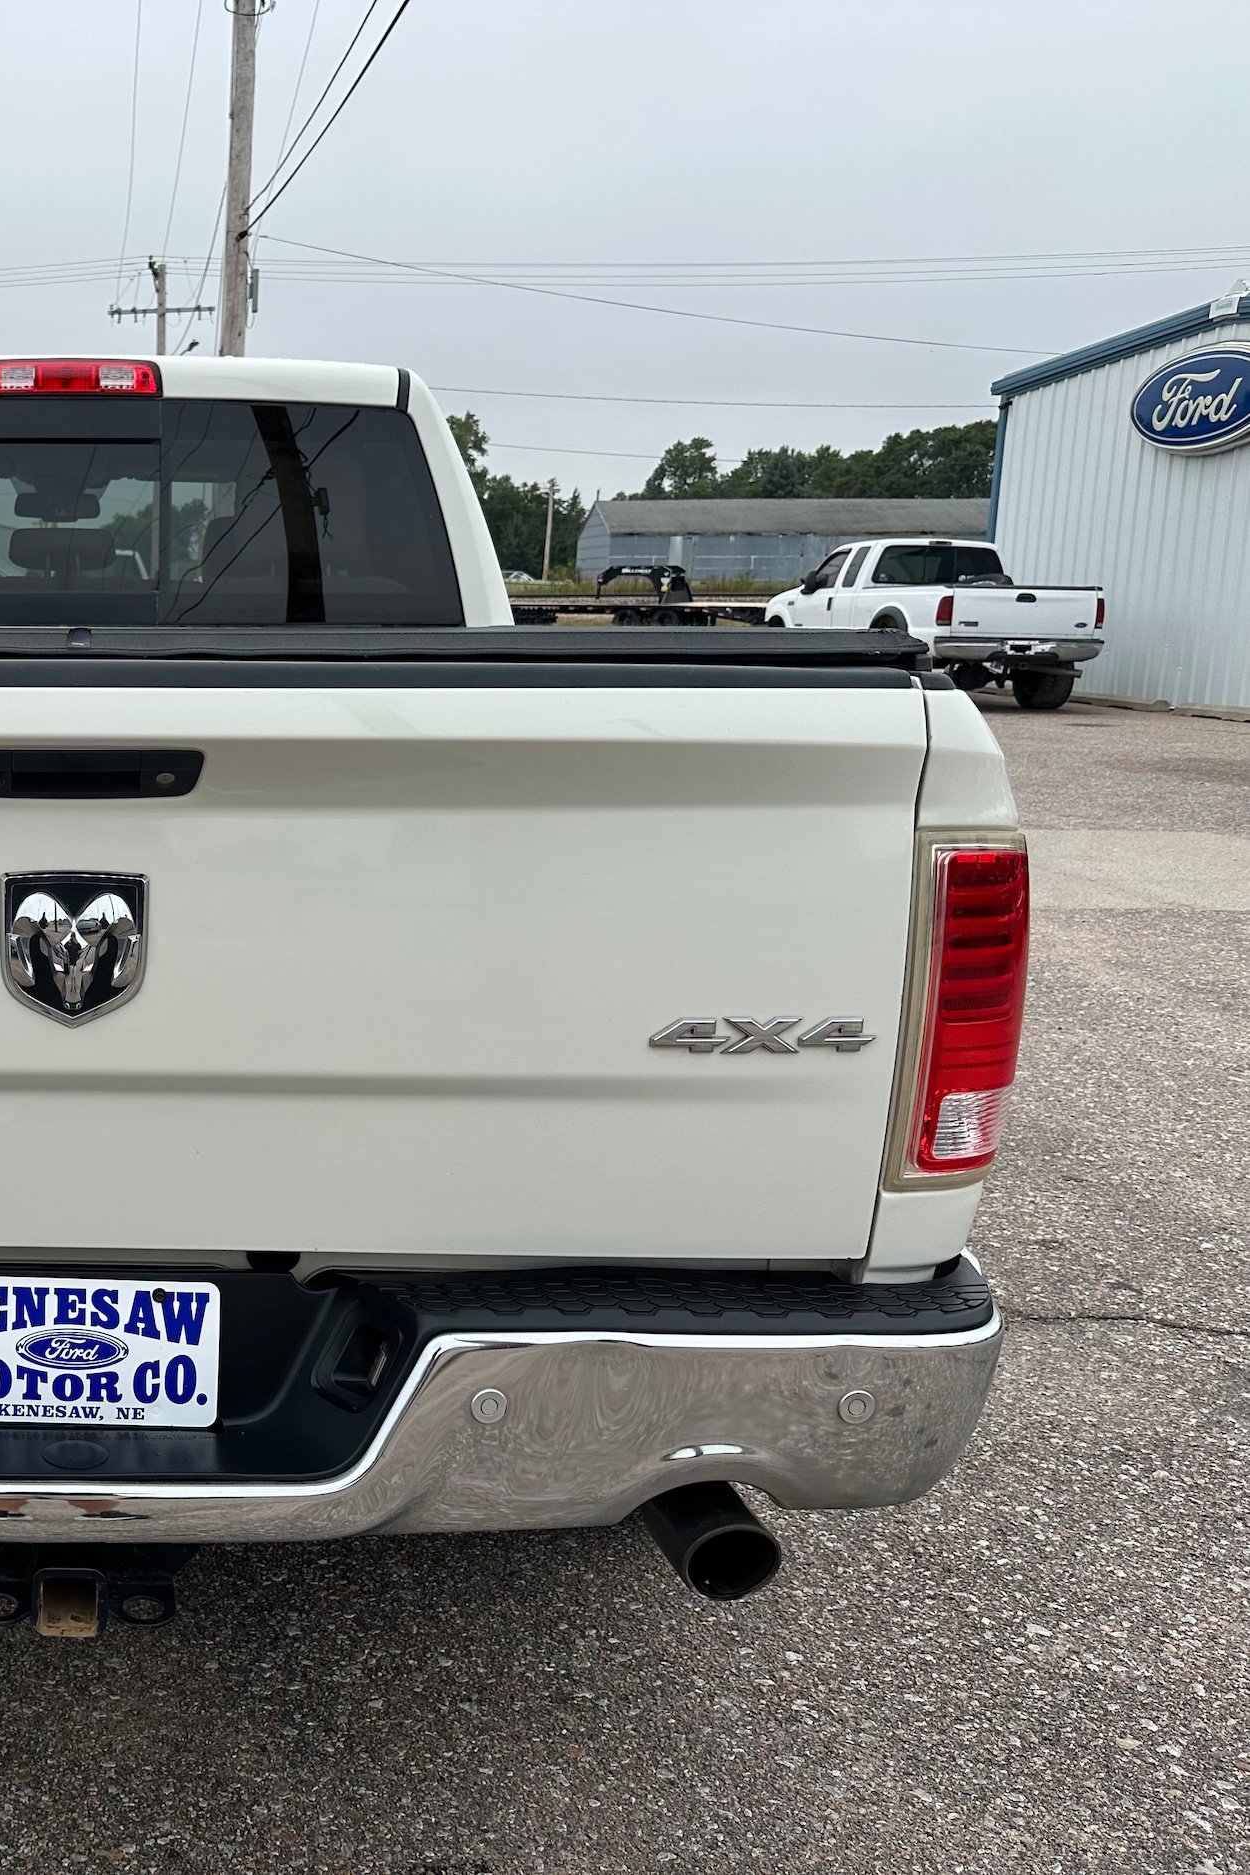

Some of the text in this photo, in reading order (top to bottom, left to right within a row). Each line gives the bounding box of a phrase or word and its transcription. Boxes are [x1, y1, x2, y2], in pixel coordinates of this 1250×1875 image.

[1152, 368, 1243, 431] Ford
[44, 1337, 100, 1361] Ford
[133, 1354, 208, 1406] CO.
[115, 1407, 145, 1420] NE
